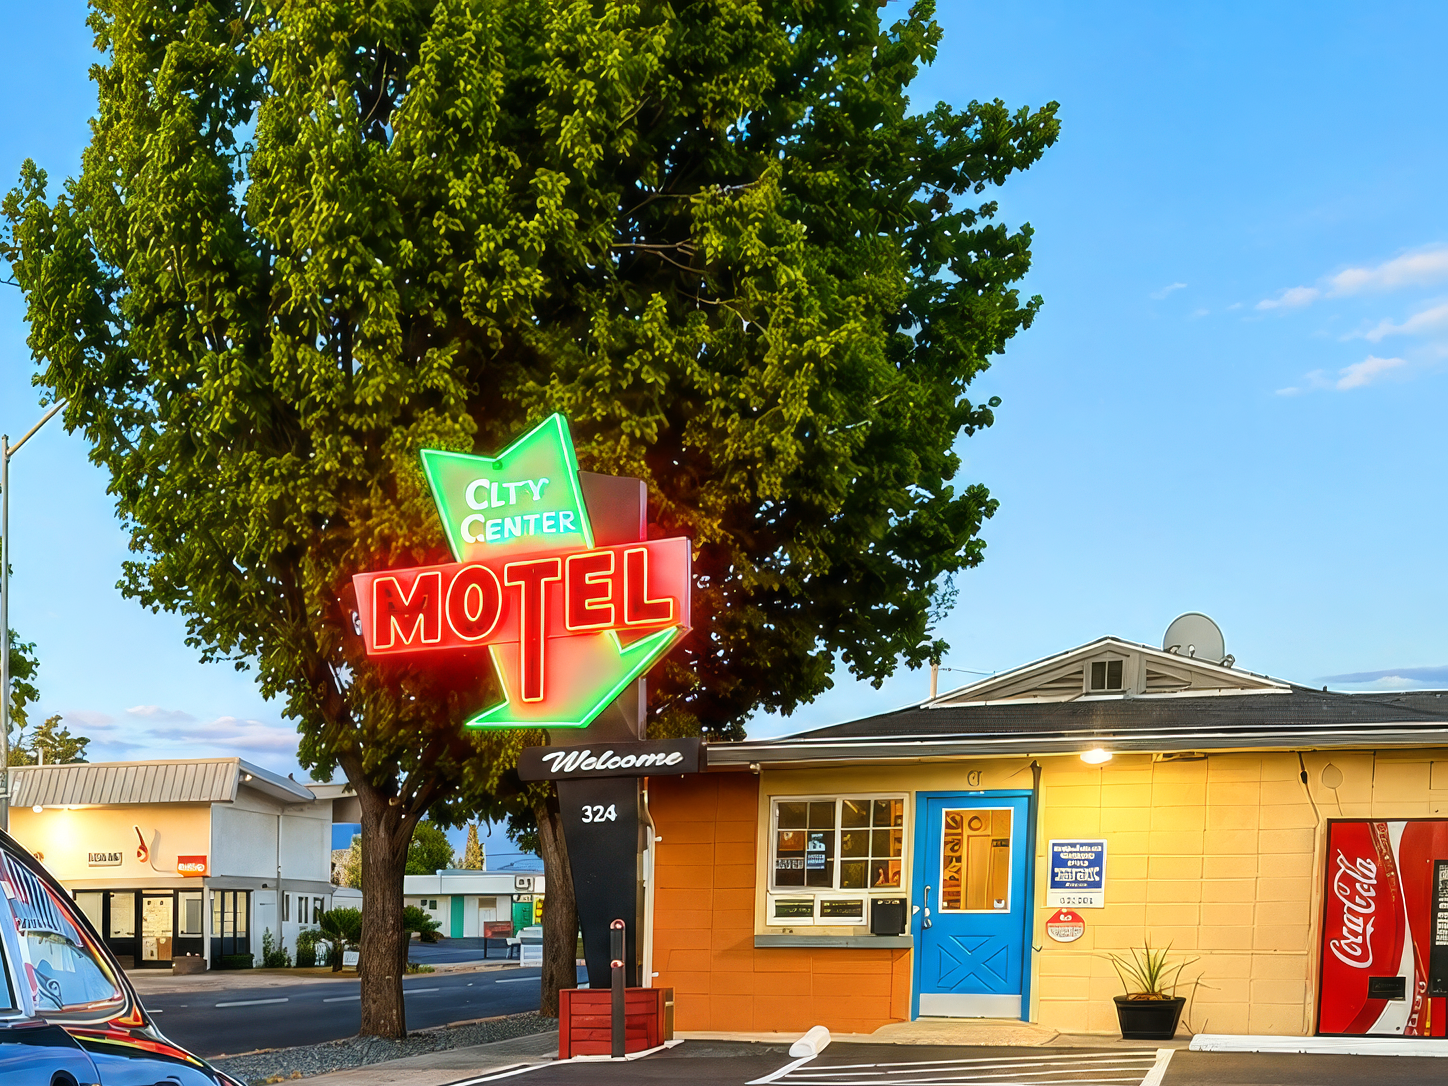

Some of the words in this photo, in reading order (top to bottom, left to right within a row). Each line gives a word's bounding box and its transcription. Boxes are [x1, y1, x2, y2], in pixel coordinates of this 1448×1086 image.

[460, 511, 577, 544] CENTER
[372, 548, 674, 703] MOTEL
[581, 803, 618, 824] 324
